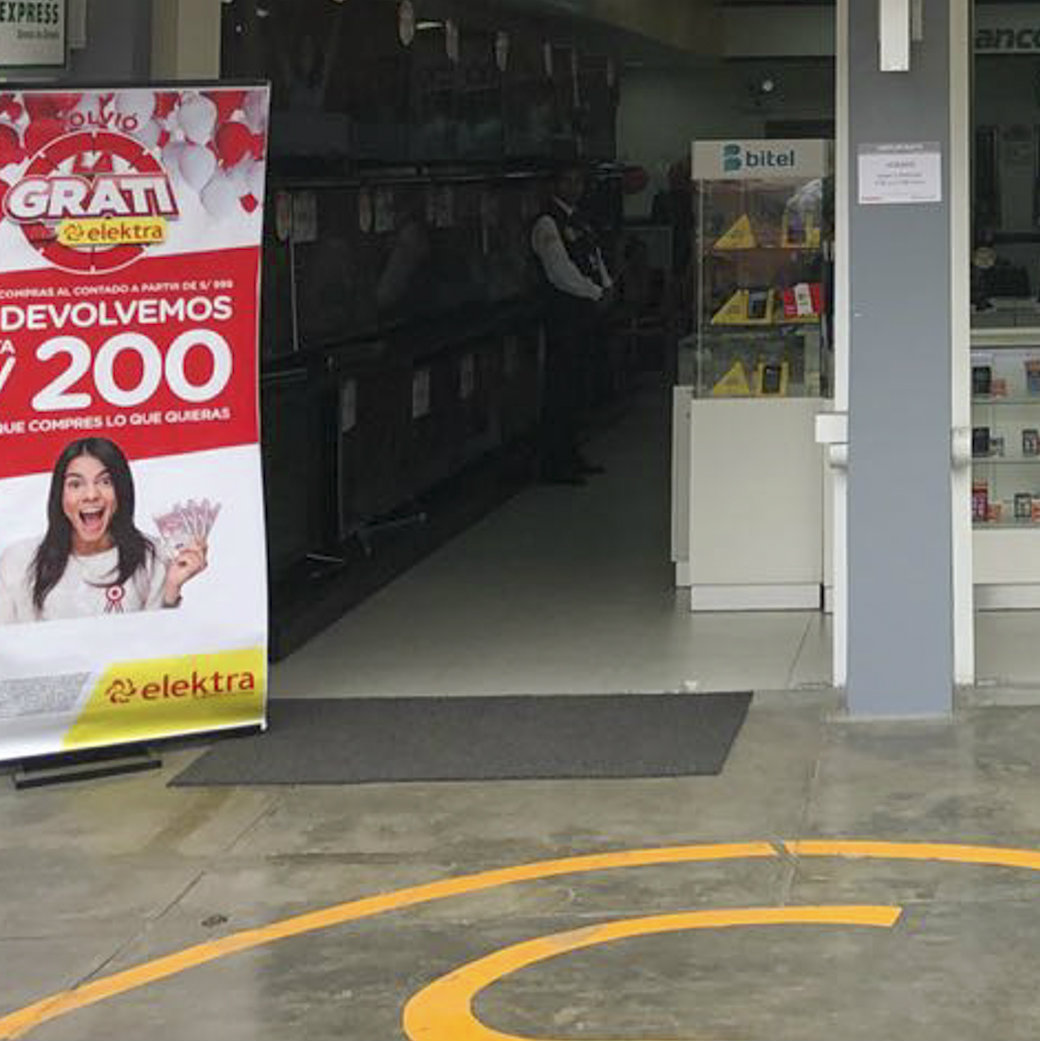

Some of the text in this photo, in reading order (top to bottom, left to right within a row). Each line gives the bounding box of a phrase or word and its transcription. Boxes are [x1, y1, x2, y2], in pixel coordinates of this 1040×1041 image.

[0, 1, 59, 25] EXPRESS
[746, 150, 795, 167] bitel
[9, 179, 175, 218] GRATI
[87, 222, 162, 241] elektra
[73, 284, 128, 296] CONTADO
[1, 296, 233, 331] DEVOLVEMOS
[32, 330, 232, 411] 200
[28, 416, 103, 432] COMPRES
[106, 414, 126, 428] LO
[130, 411, 161, 426] QUE
[165, 407, 230, 423] QUIERAS
[141, 671, 255, 700] elektra
